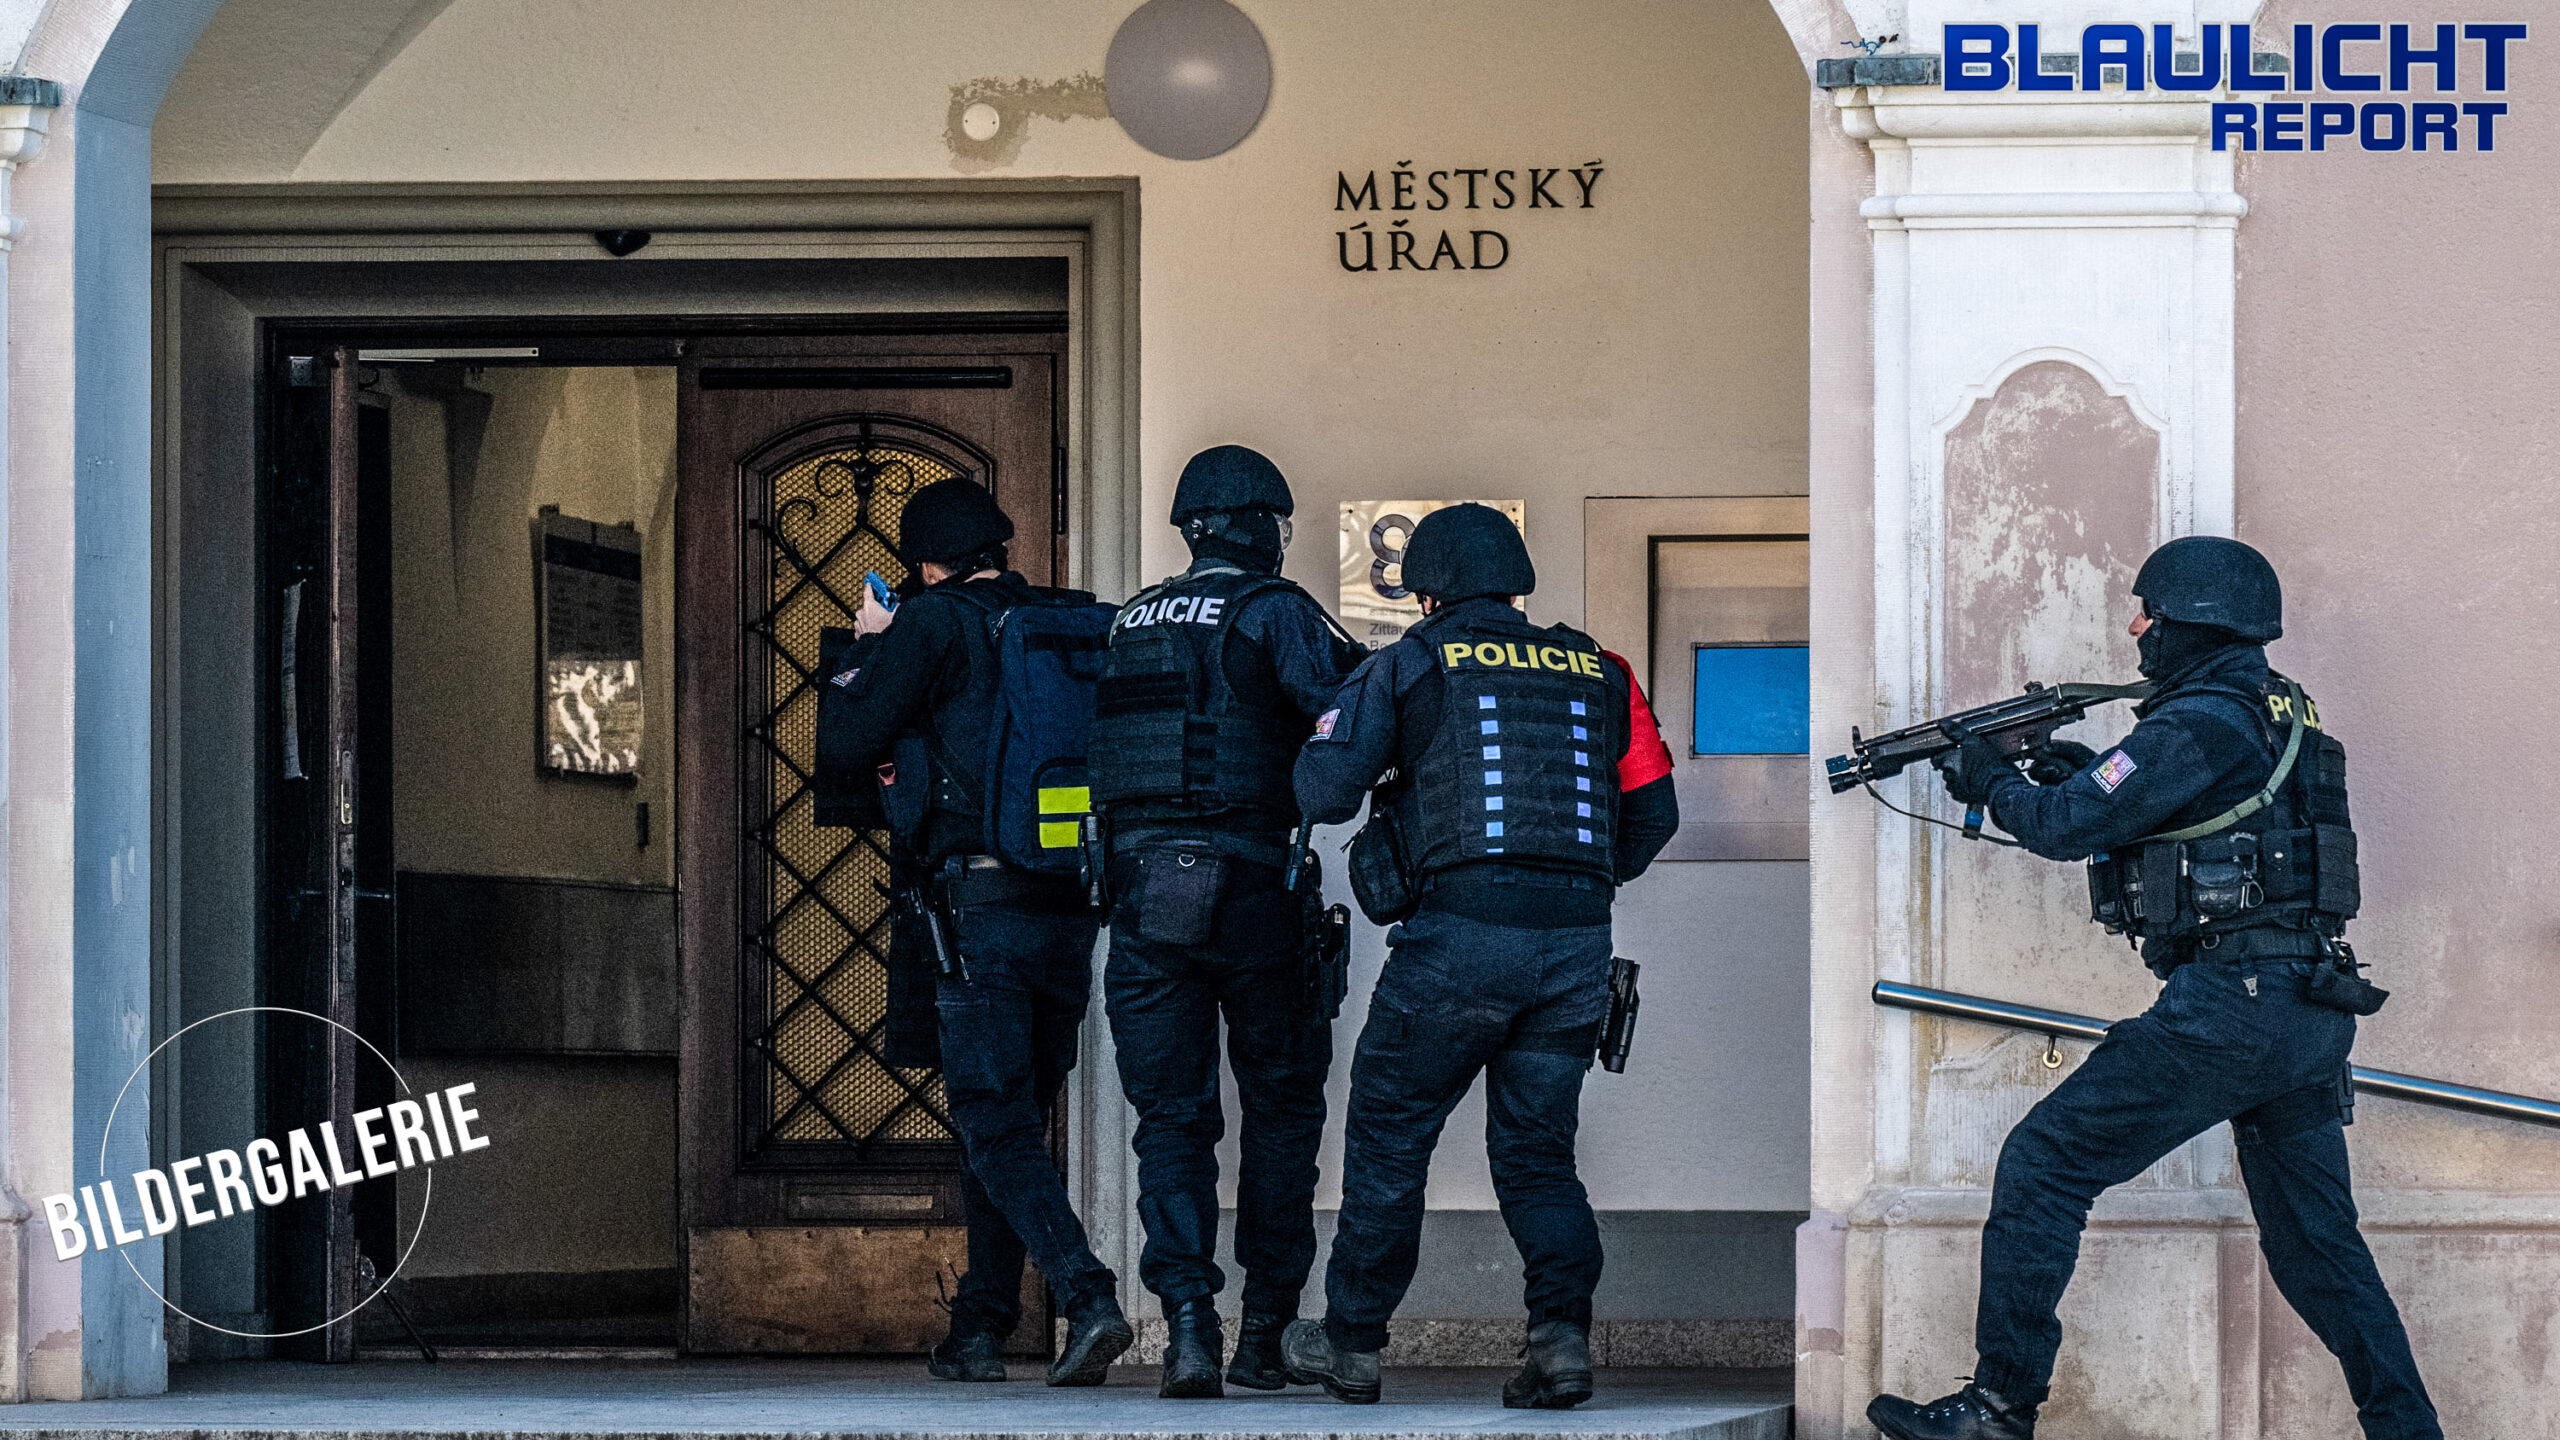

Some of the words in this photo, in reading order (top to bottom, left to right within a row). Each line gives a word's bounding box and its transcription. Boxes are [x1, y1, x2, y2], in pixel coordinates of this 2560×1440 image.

[1334, 158, 1605, 211] MĚSTSKÝ
[1335, 219, 1508, 272] ÚŘAD
[1442, 642, 1604, 678] POLICIE
